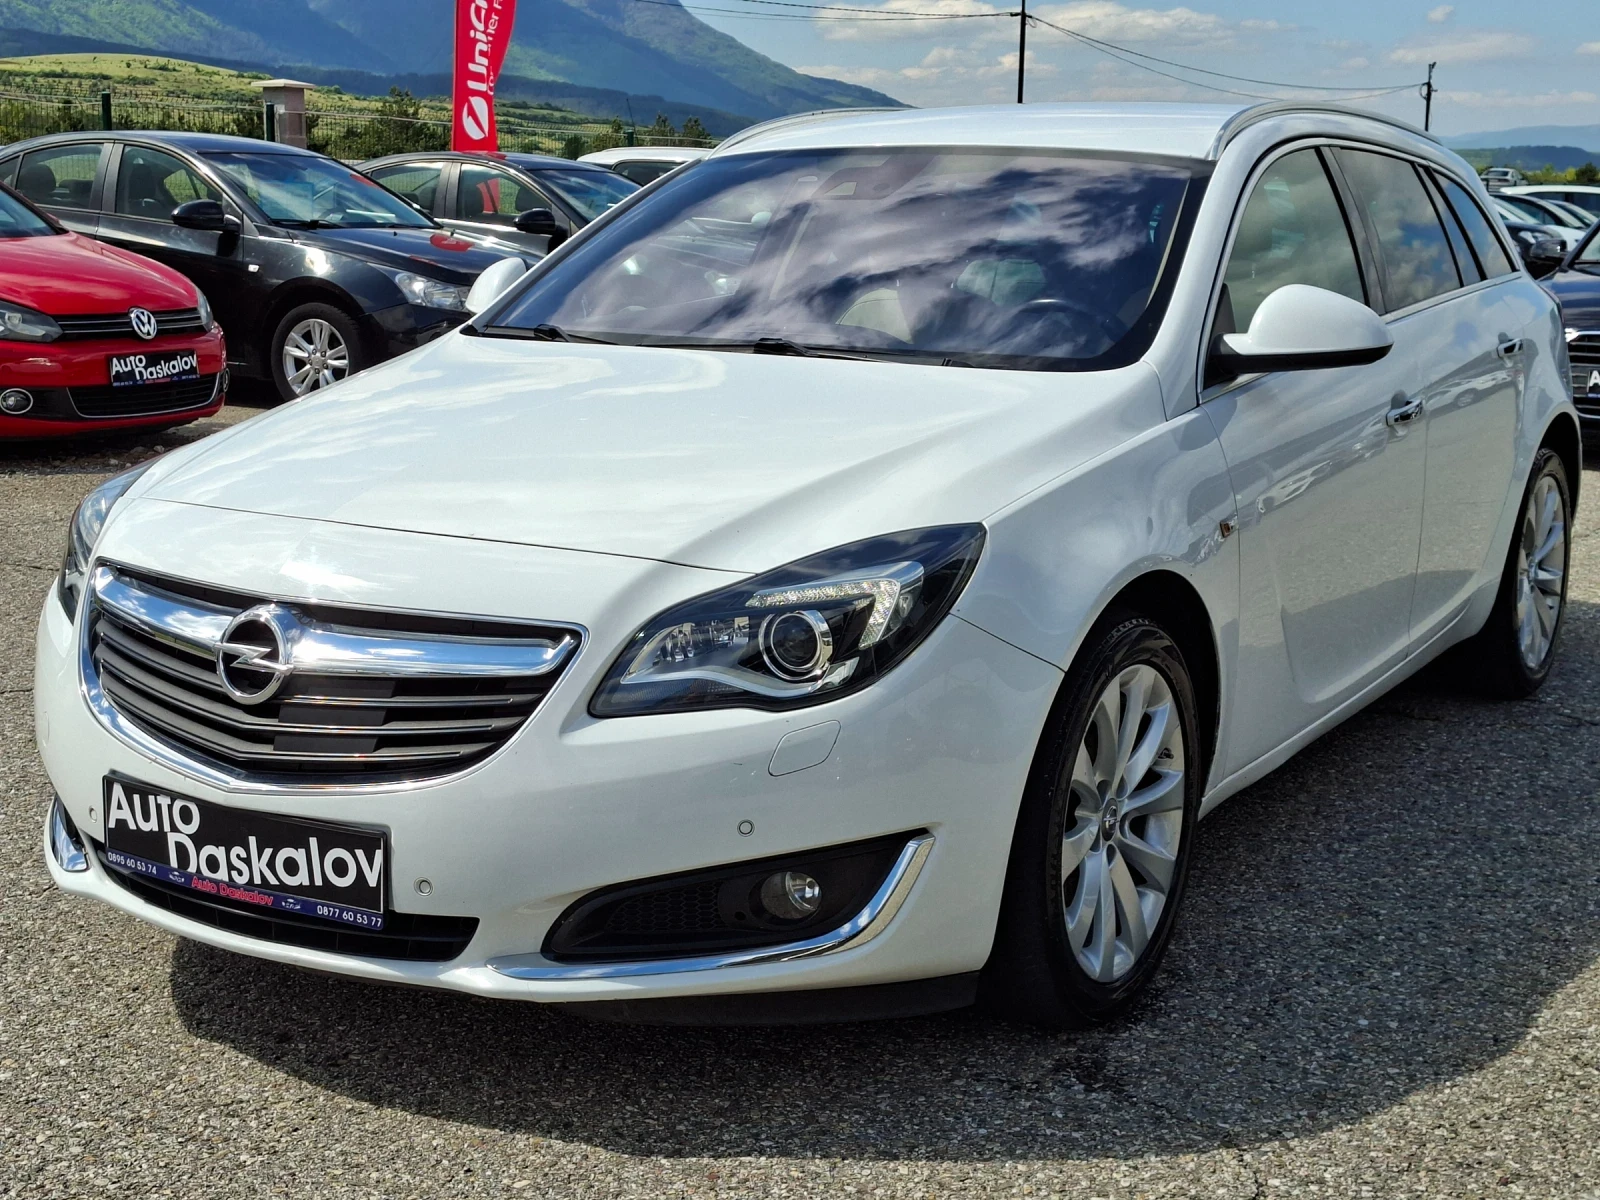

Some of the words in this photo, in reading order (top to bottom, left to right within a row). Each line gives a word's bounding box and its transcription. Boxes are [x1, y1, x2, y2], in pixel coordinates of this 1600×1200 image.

[134, 353, 197, 380] Daskalov
[108, 781, 200, 835] Auto
[108, 852, 125, 866] 0895
[126, 858, 136, 868] 60
[137, 862, 146, 871] 53
[148, 864, 157, 875] 74
[167, 832, 382, 888] Daskalov
[191, 876, 217, 893] Auto
[219, 884, 274, 907] Daskalov
[317, 905, 339, 918] 0877
[342, 910, 354, 921] 60
[356, 912, 368, 924] 53
[371, 917, 382, 927] 77
